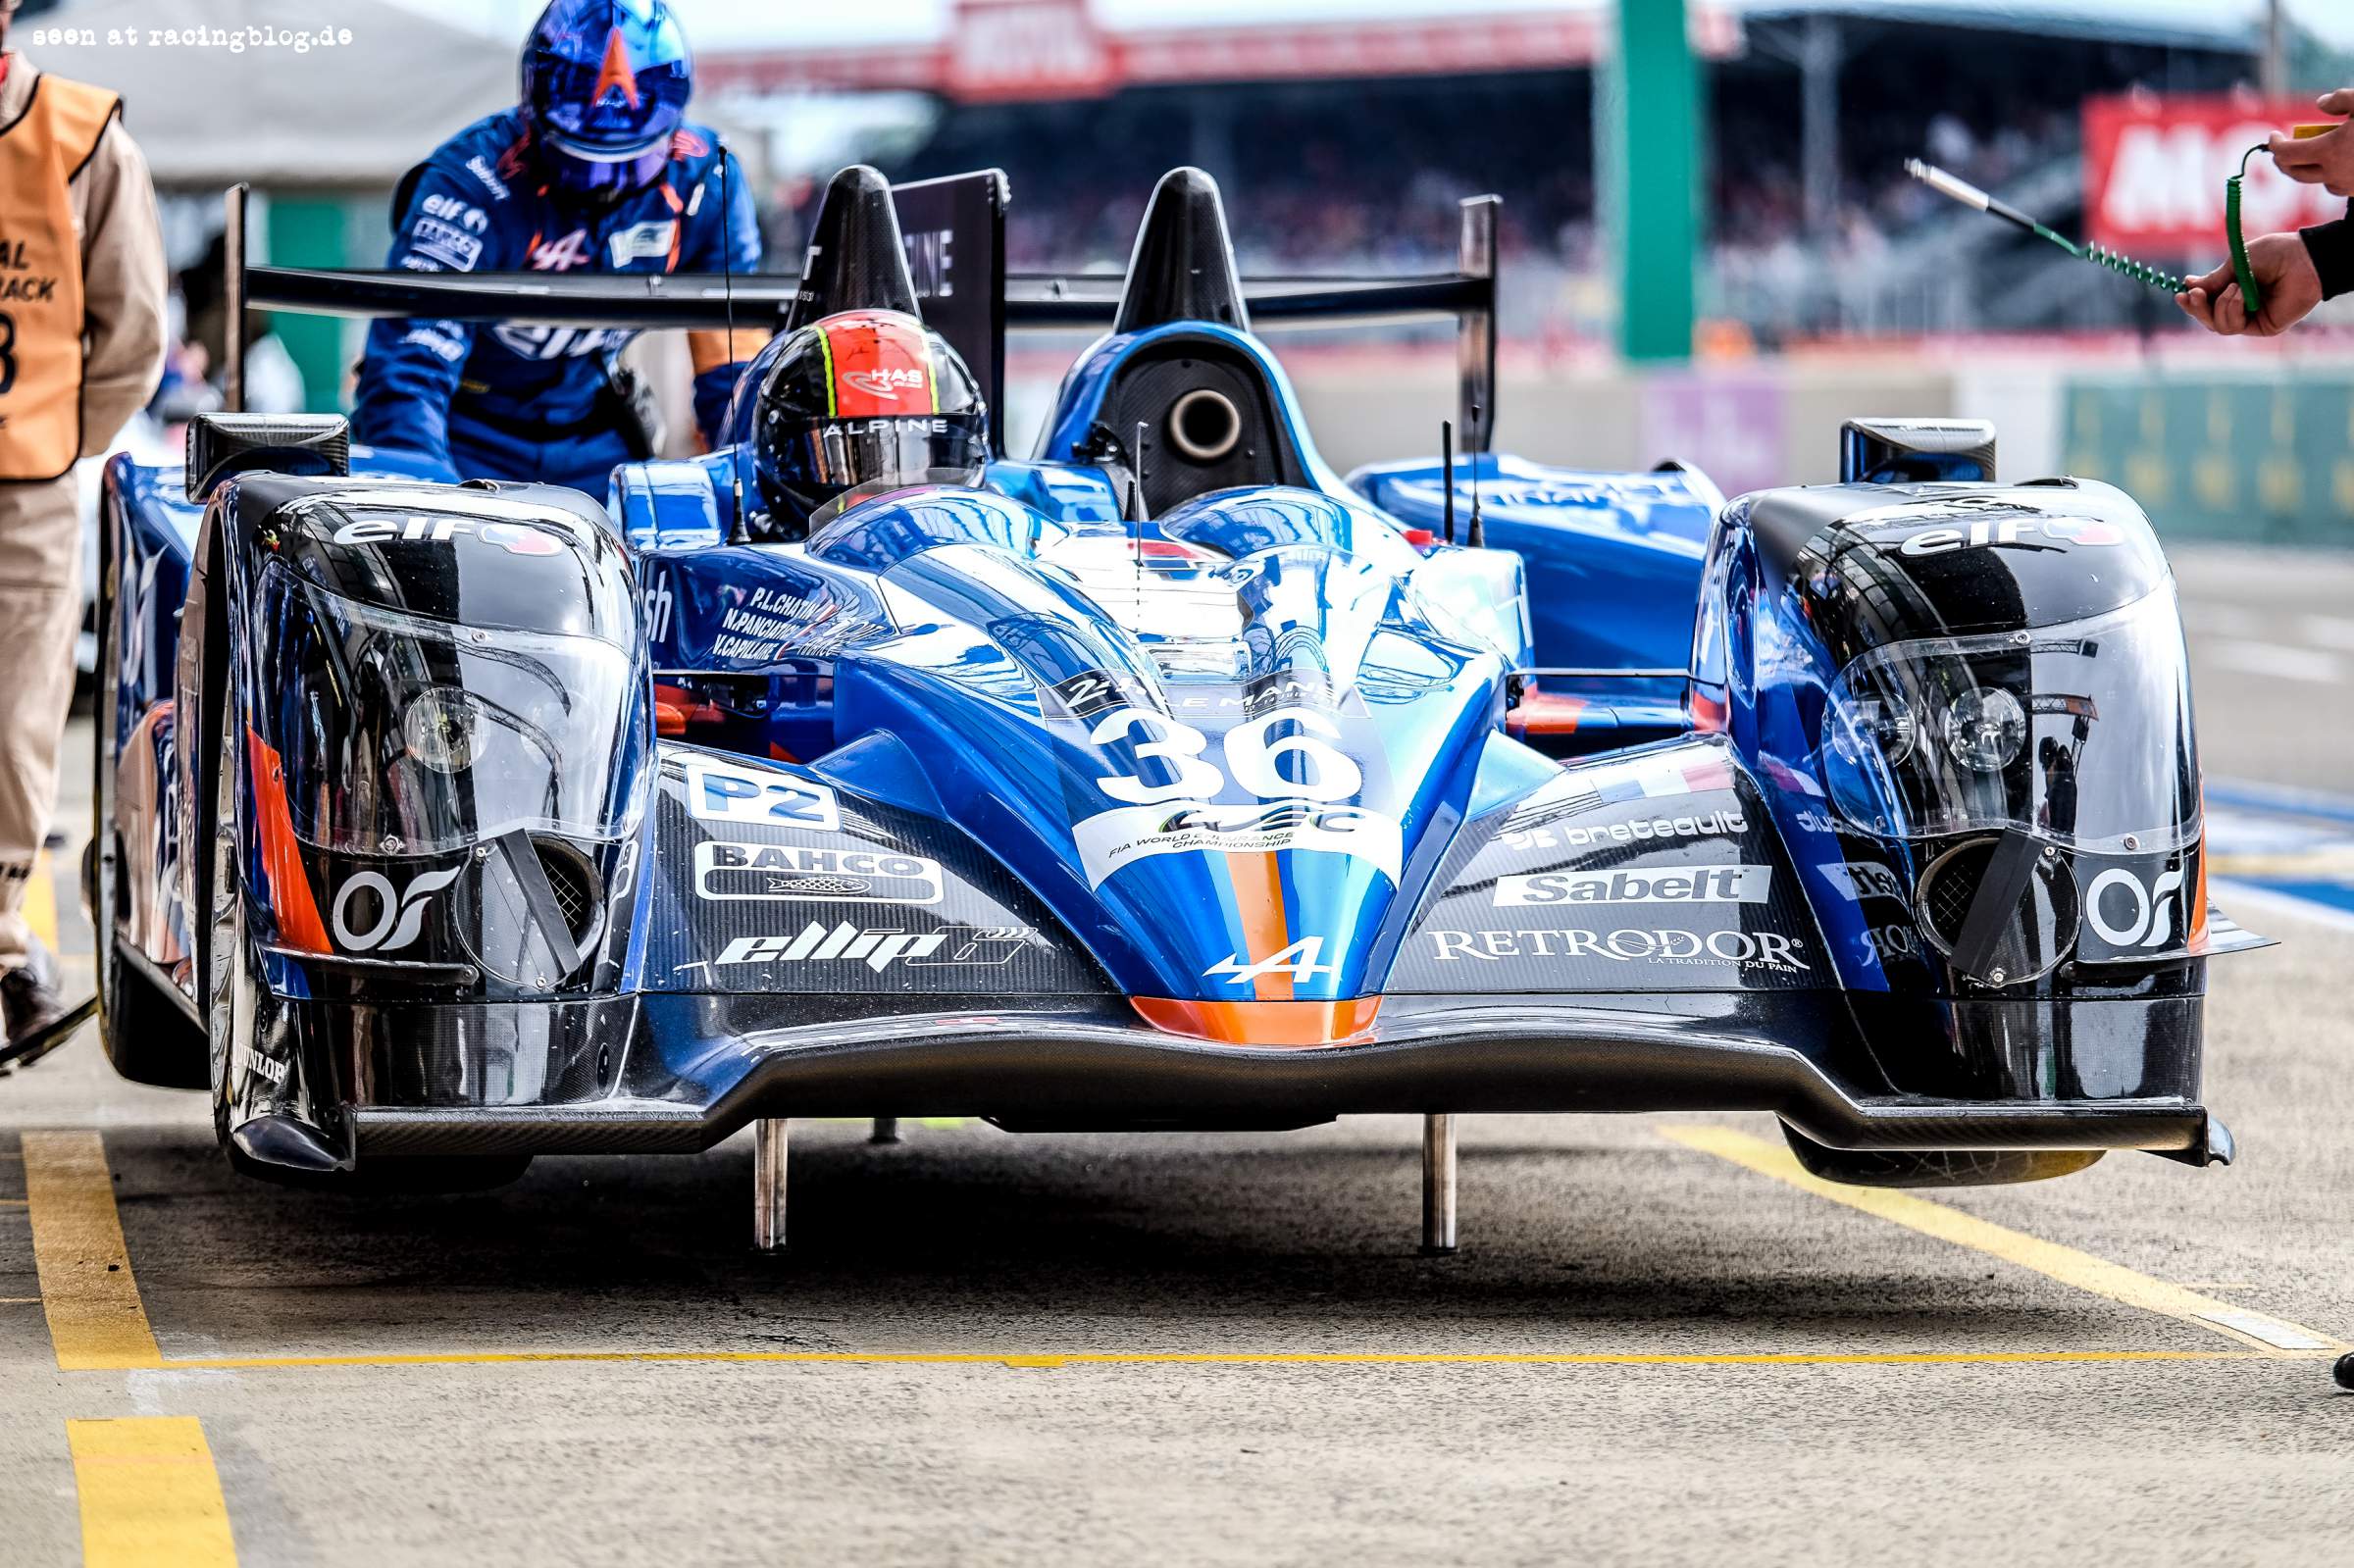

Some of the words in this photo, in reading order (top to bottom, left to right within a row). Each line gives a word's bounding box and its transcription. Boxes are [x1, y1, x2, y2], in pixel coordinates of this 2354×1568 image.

[0, 278, 57, 302] ACK
[822, 419, 948, 439] ALPINE
[333, 517, 475, 545] elf
[1900, 520, 2038, 556] elf
[1090, 707, 1361, 804] 36
[702, 773, 825, 822] P2
[713, 844, 924, 877] BAHCO
[1108, 841, 1131, 859] FIA
[1136, 833, 1191, 846] WORLD
[1522, 869, 1741, 902] Sabelt
[1668, 958, 1741, 967] TRADITION
[1767, 963, 1798, 973] PAIN
